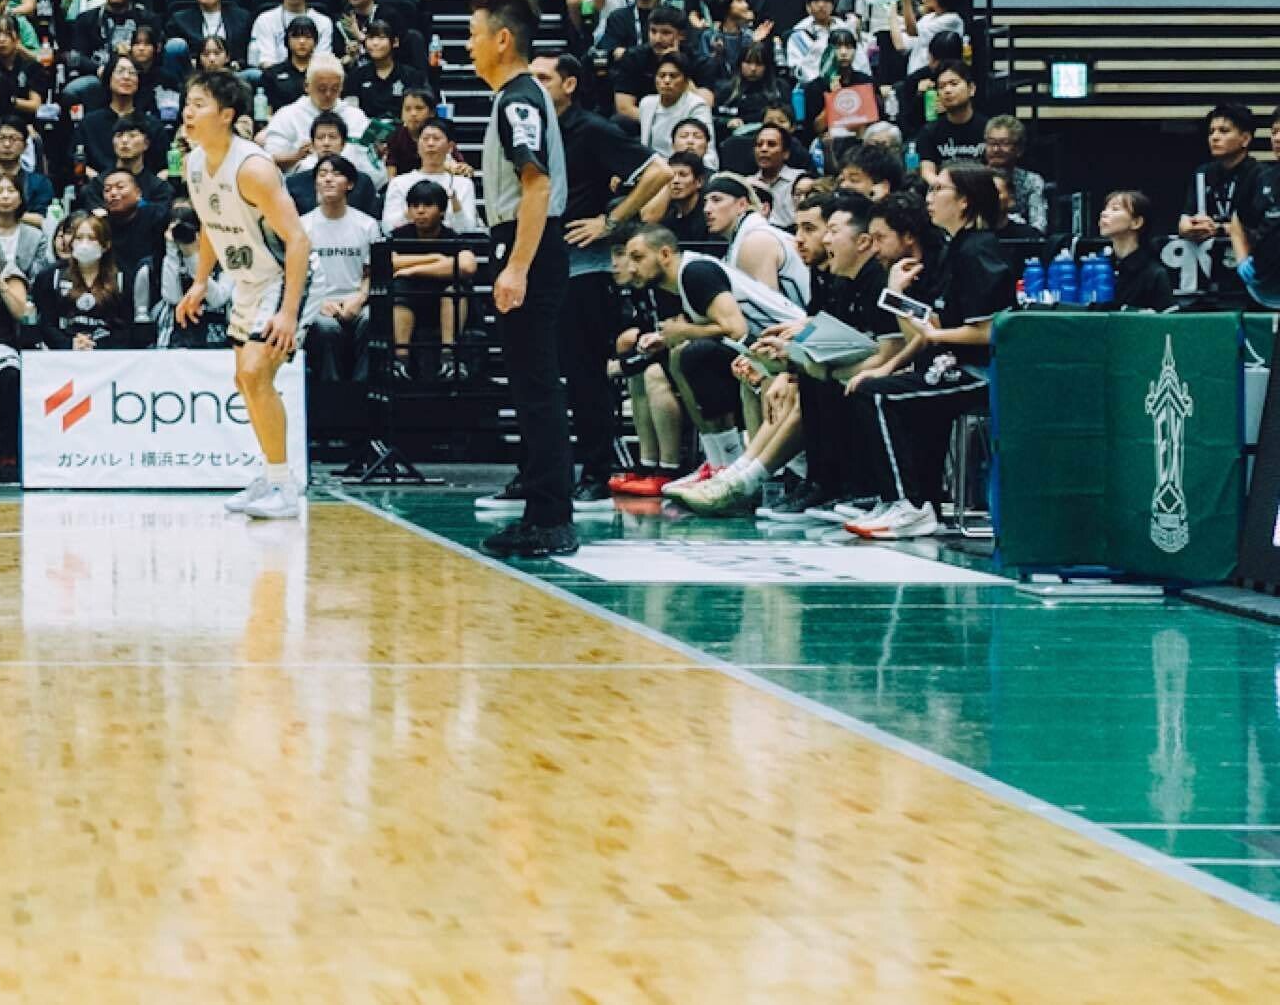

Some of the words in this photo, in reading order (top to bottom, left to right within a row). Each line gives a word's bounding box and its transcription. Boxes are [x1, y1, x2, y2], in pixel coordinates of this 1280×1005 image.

[112, 381, 283, 433] bpne
[57, 452, 264, 467] ガンバレ！横浜エクセレン
